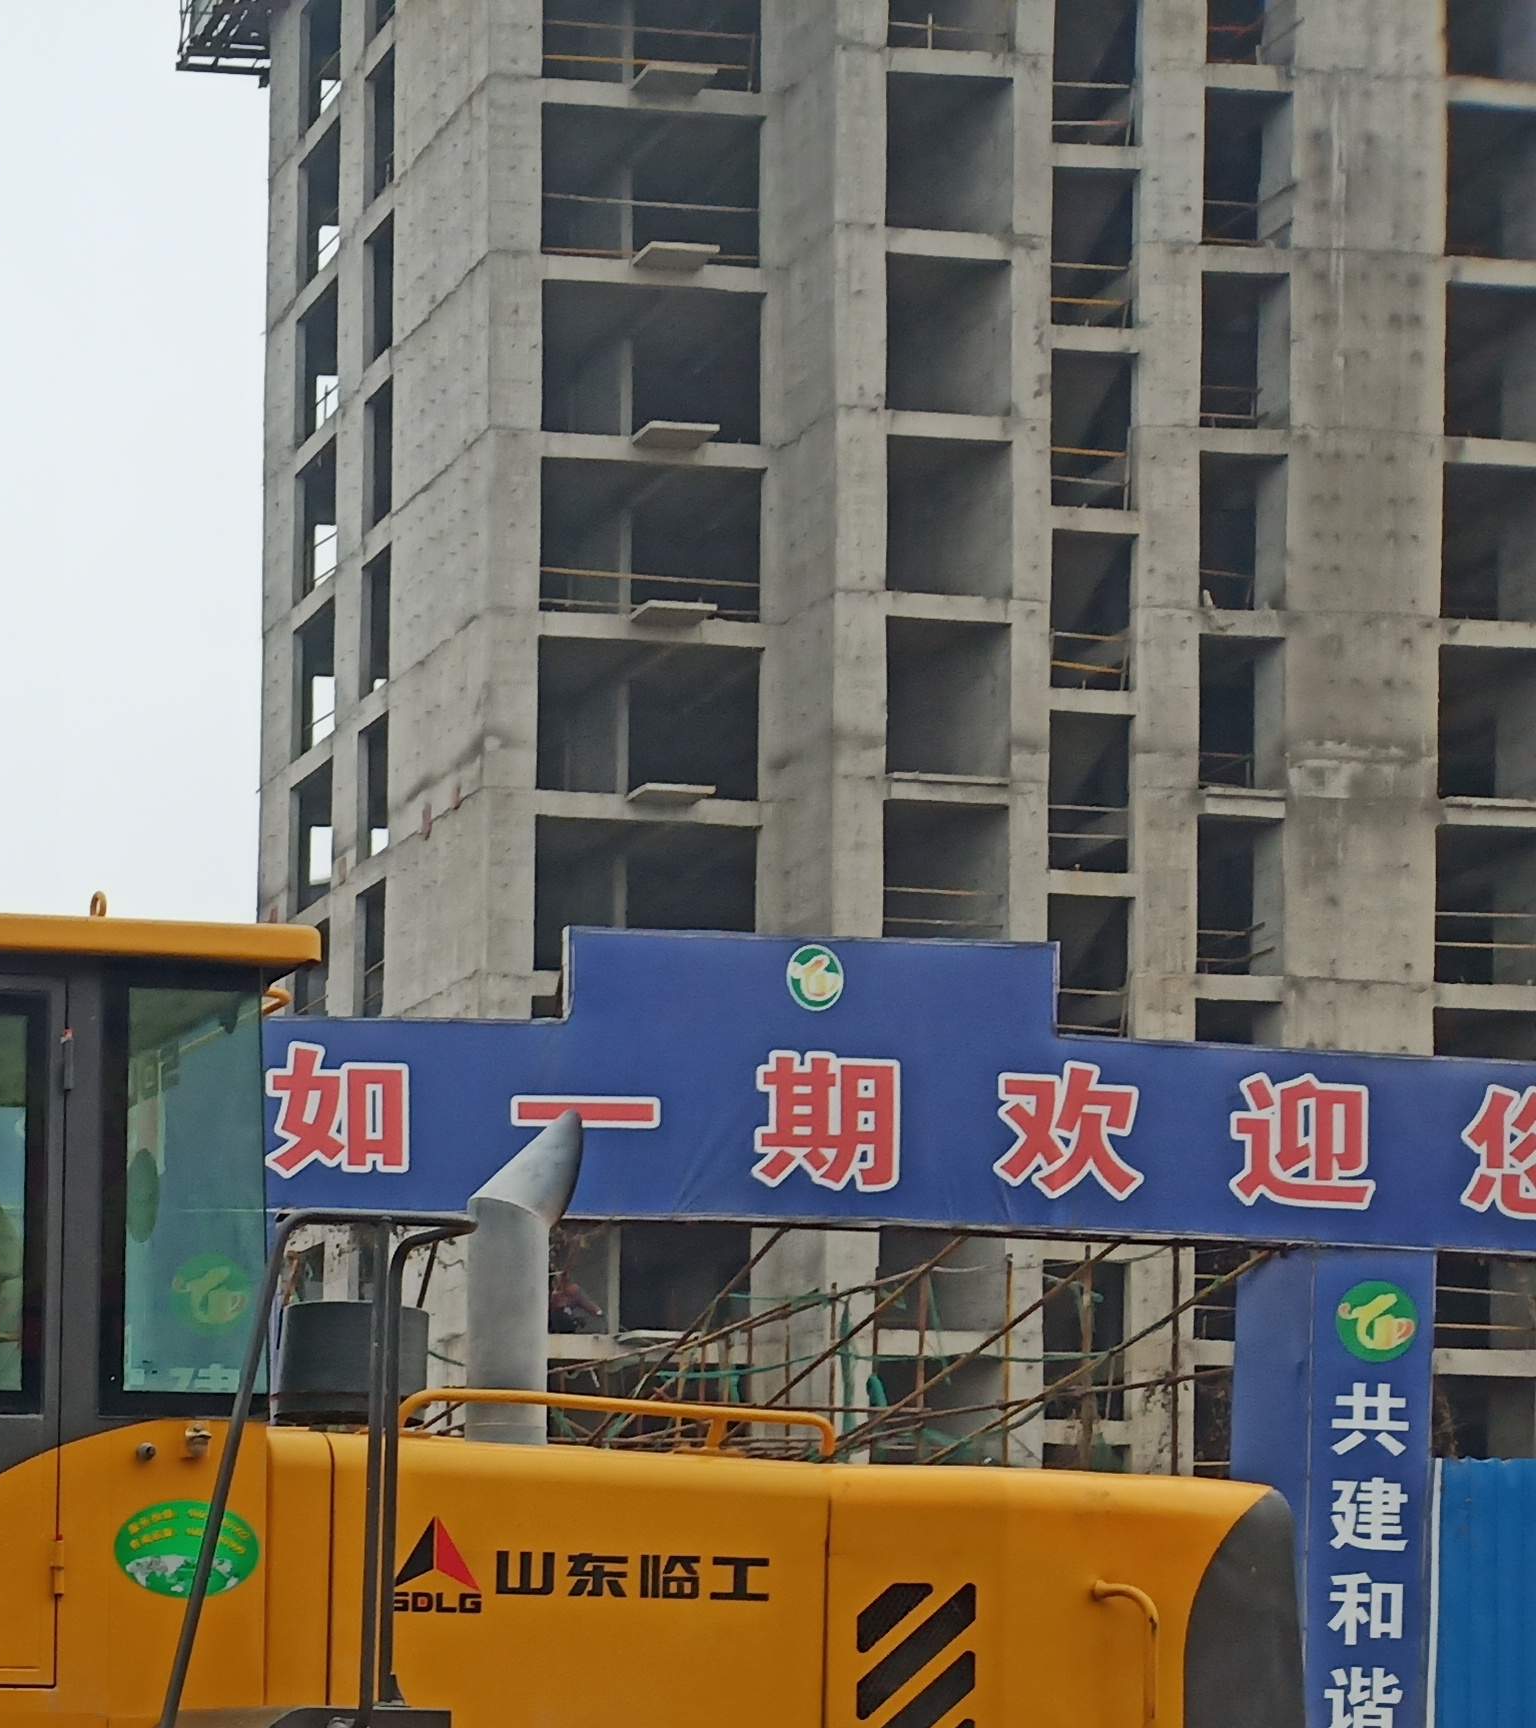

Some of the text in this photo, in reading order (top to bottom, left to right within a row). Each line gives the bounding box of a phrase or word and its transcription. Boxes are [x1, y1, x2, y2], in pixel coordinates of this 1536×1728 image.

[496, 1551, 770, 1602] 山东临工
[393, 1591, 483, 1614] SDLG
